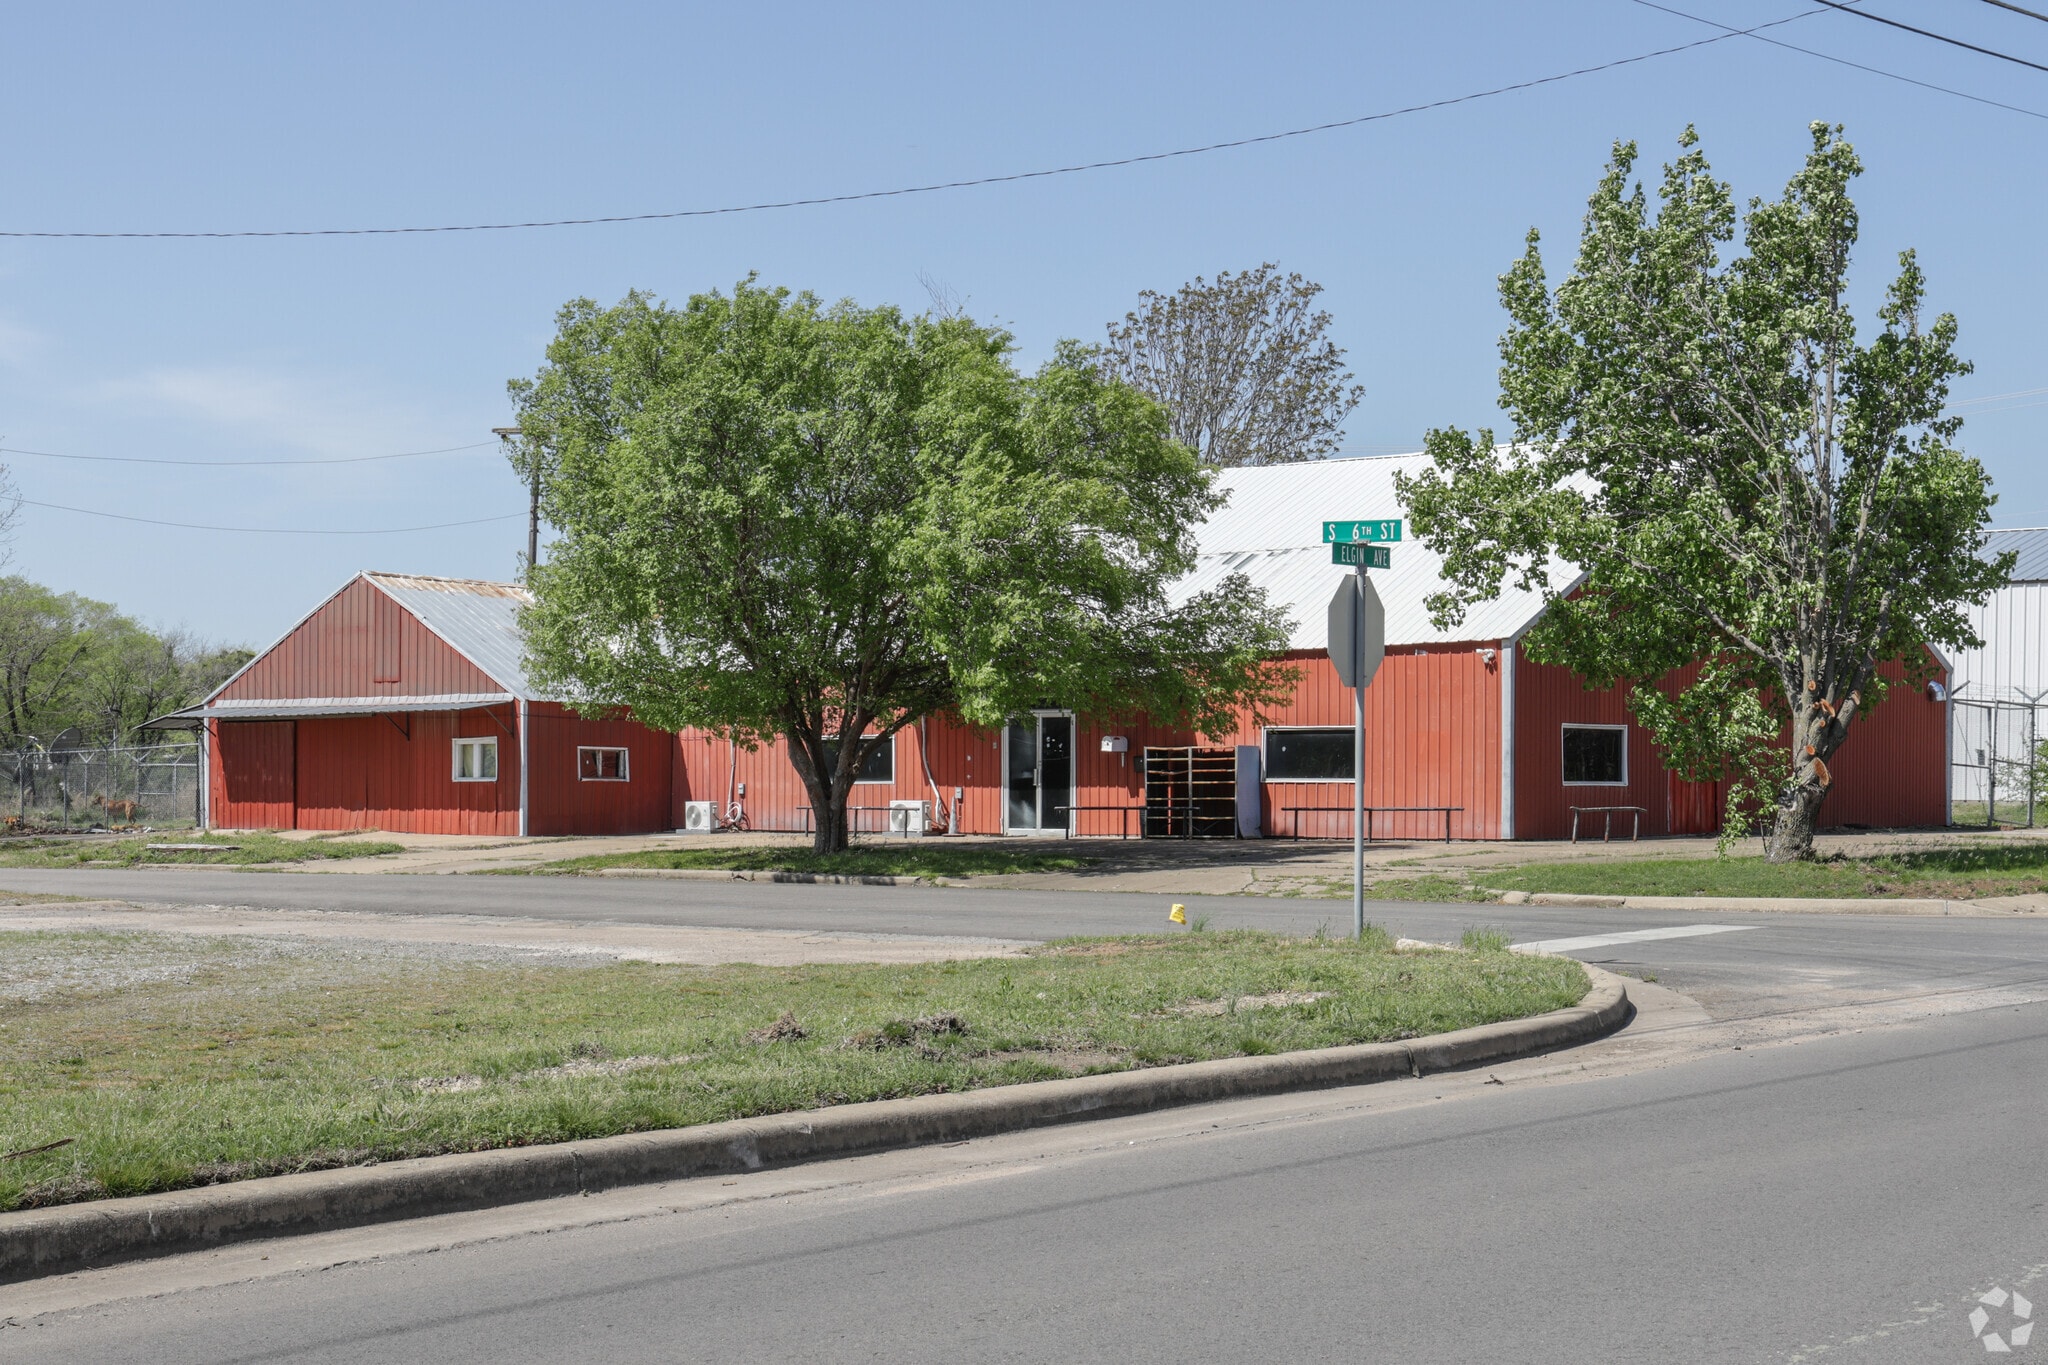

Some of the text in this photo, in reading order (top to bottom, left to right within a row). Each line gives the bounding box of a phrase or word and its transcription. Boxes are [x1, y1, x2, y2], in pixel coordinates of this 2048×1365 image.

[1328, 522, 1396, 541] S 6TH ST
[1341, 545, 1387, 566] ELGIN AVE
